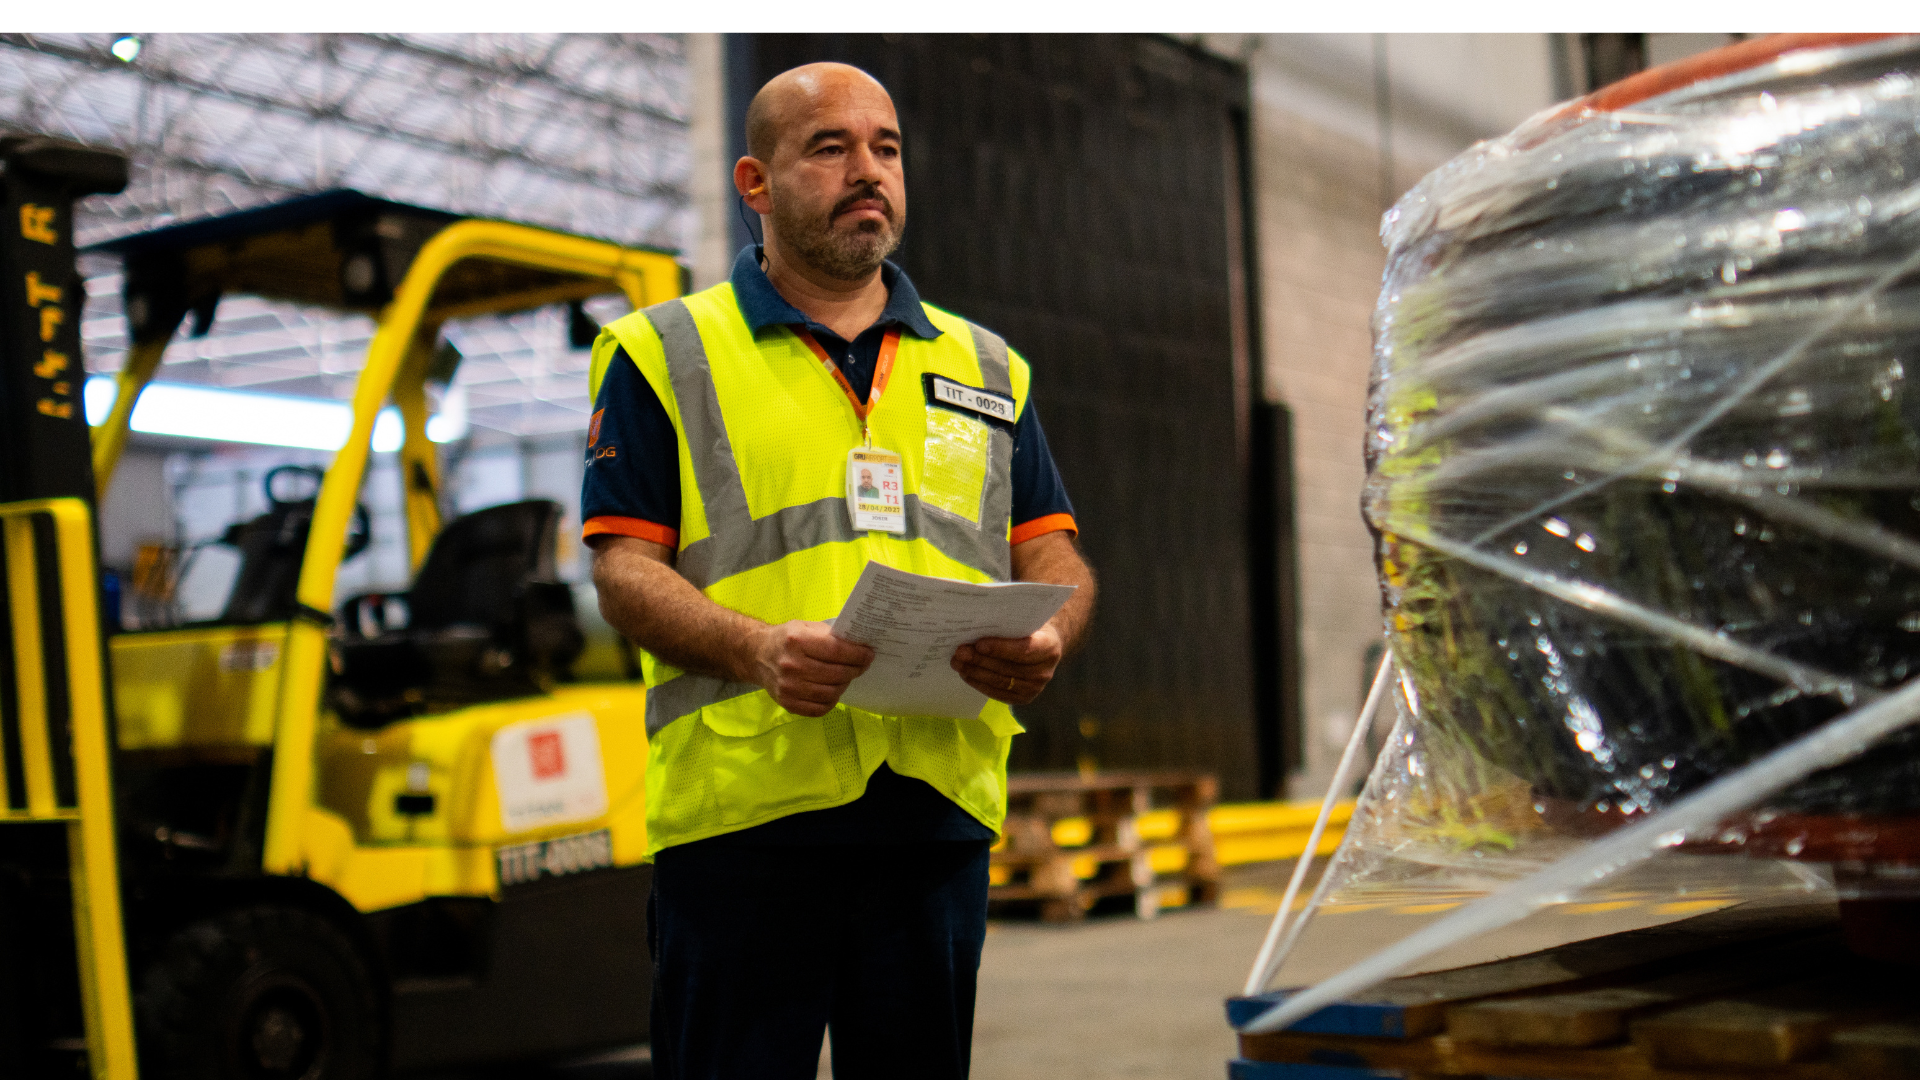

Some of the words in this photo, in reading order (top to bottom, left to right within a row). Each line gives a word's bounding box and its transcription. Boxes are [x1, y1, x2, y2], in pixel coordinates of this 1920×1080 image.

[943, 385, 964, 402] TIT
[882, 480, 898, 491] R3
[884, 494, 899, 505] T1
